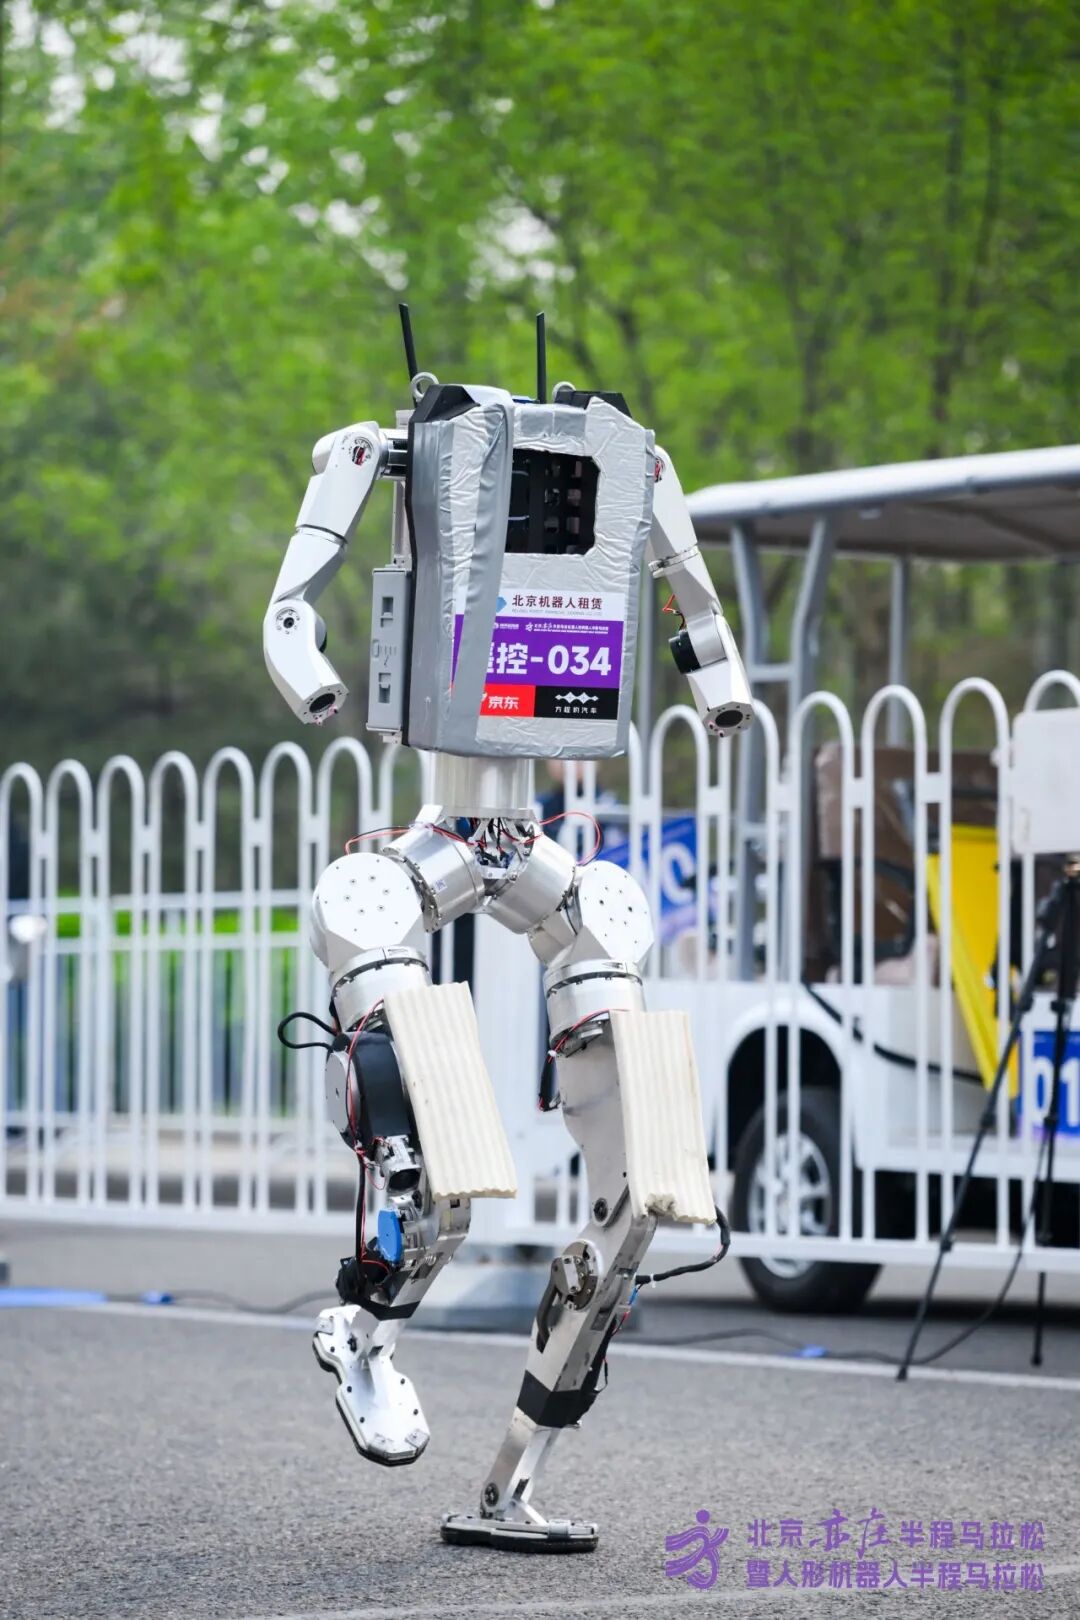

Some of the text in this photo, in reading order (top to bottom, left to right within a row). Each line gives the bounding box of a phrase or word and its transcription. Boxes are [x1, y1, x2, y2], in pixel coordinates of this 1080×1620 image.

[512, 595, 602, 609] 北京机器人租赁
[486, 642, 612, 676] 控-034
[488, 695, 519, 710] 京东
